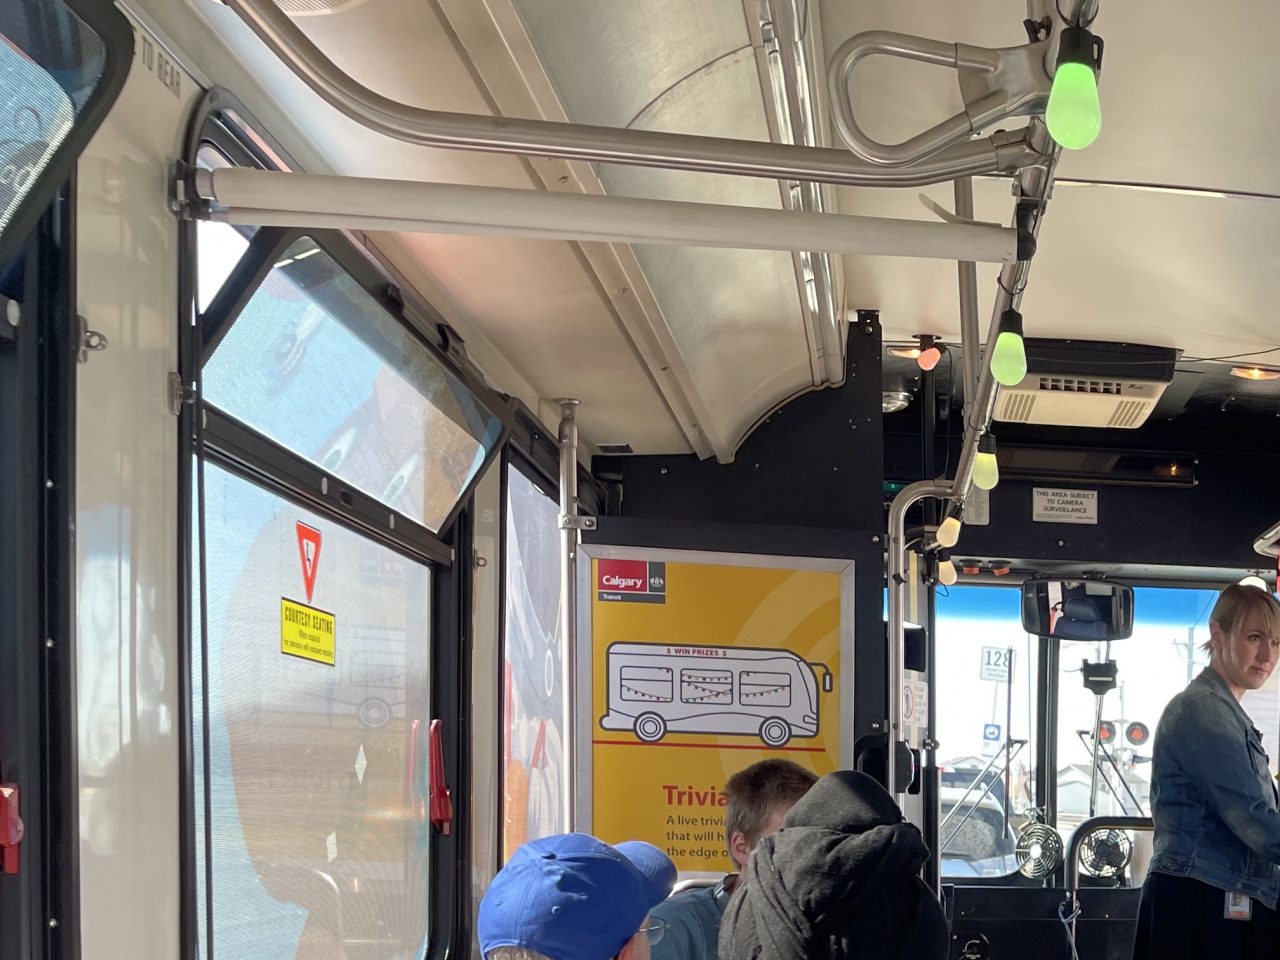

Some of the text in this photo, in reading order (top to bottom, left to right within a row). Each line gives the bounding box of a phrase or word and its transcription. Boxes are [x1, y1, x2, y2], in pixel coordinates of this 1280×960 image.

[142, 35, 180, 99] TO REAR
[602, 575, 643, 589] Calgary
[285, 606, 333, 635] COURTESY SEATING
[662, 785, 728, 806] Trivia
[667, 815, 675, 825] A
[678, 815, 698, 826] live
[666, 831, 690, 841] that
[694, 831, 714, 842] will
[666, 846, 686, 857] the
[689, 847, 719, 860] edge
